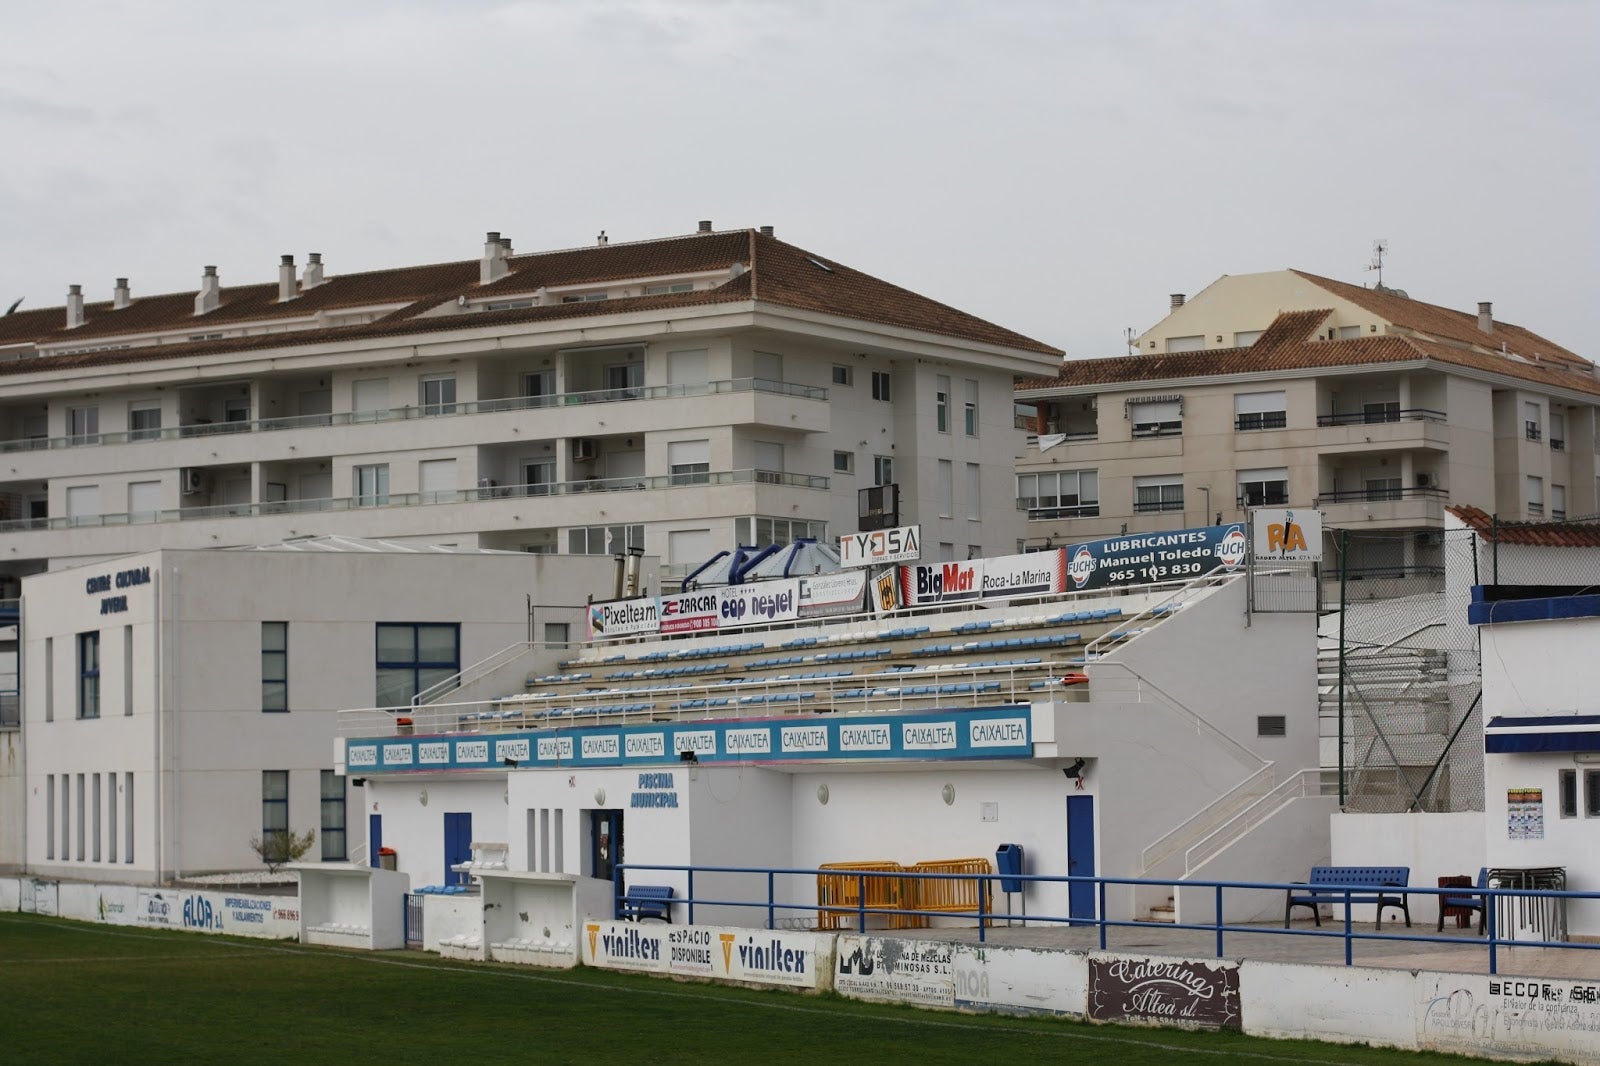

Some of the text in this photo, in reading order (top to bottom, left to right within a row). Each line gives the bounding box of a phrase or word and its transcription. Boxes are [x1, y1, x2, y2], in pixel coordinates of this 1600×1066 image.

[841, 528, 918, 560] TYOSA
[1103, 531, 1207, 554] LUBRICANTES
[1214, 540, 1245, 558] FUCH
[1068, 558, 1096, 575] FUCHS
[1099, 547, 1212, 569] Manuel Toledo
[86, 566, 151, 595] CENTRE CULTURAL
[1023, 569, 1051, 584] Marina
[1109, 563, 1202, 581] 965 103 830
[917, 564, 975, 602] BigMat
[721, 588, 738, 598] HOTEL
[101, 595, 128, 614] JUVENIL
[679, 595, 717, 613] ZARCAR
[604, 604, 657, 626] Pixelteam
[727, 733, 769, 748] CAIXALTEA
[783, 731, 826, 747] CAIXALTEA
[841, 729, 889, 745] CAIXALTEA
[904, 727, 954, 744] CAIXALTEA
[972, 723, 1024, 742] CAIXALTEA
[498, 743, 528, 757] CAIXALTEA
[539, 741, 572, 755] CAIXALTEA
[583, 738, 617, 753] CAIXALTEA
[626, 737, 663, 752] CAIXALTEA
[675, 735, 714, 750] CAIXALTEA
[351, 748, 377, 762] CAIXALTEA
[385, 747, 411, 760] CAIXALTEA
[420, 745, 447, 760] CAIXALTEA
[457, 745, 487, 759] CAIXALTEA
[638, 772, 674, 789] PISCINA
[630, 792, 679, 808] MUNICIPAL
[183, 895, 213, 930] ALOA
[603, 926, 805, 973] viniltex viniltex
[671, 947, 711, 964] DISPONIBLE
[911, 952, 919, 962] DE
[921, 952, 952, 964] MEZCLAS
[934, 964, 952, 976] S.L.
[1109, 958, 1214, 1000] Catering
[1122, 987, 1177, 1016] Altea
